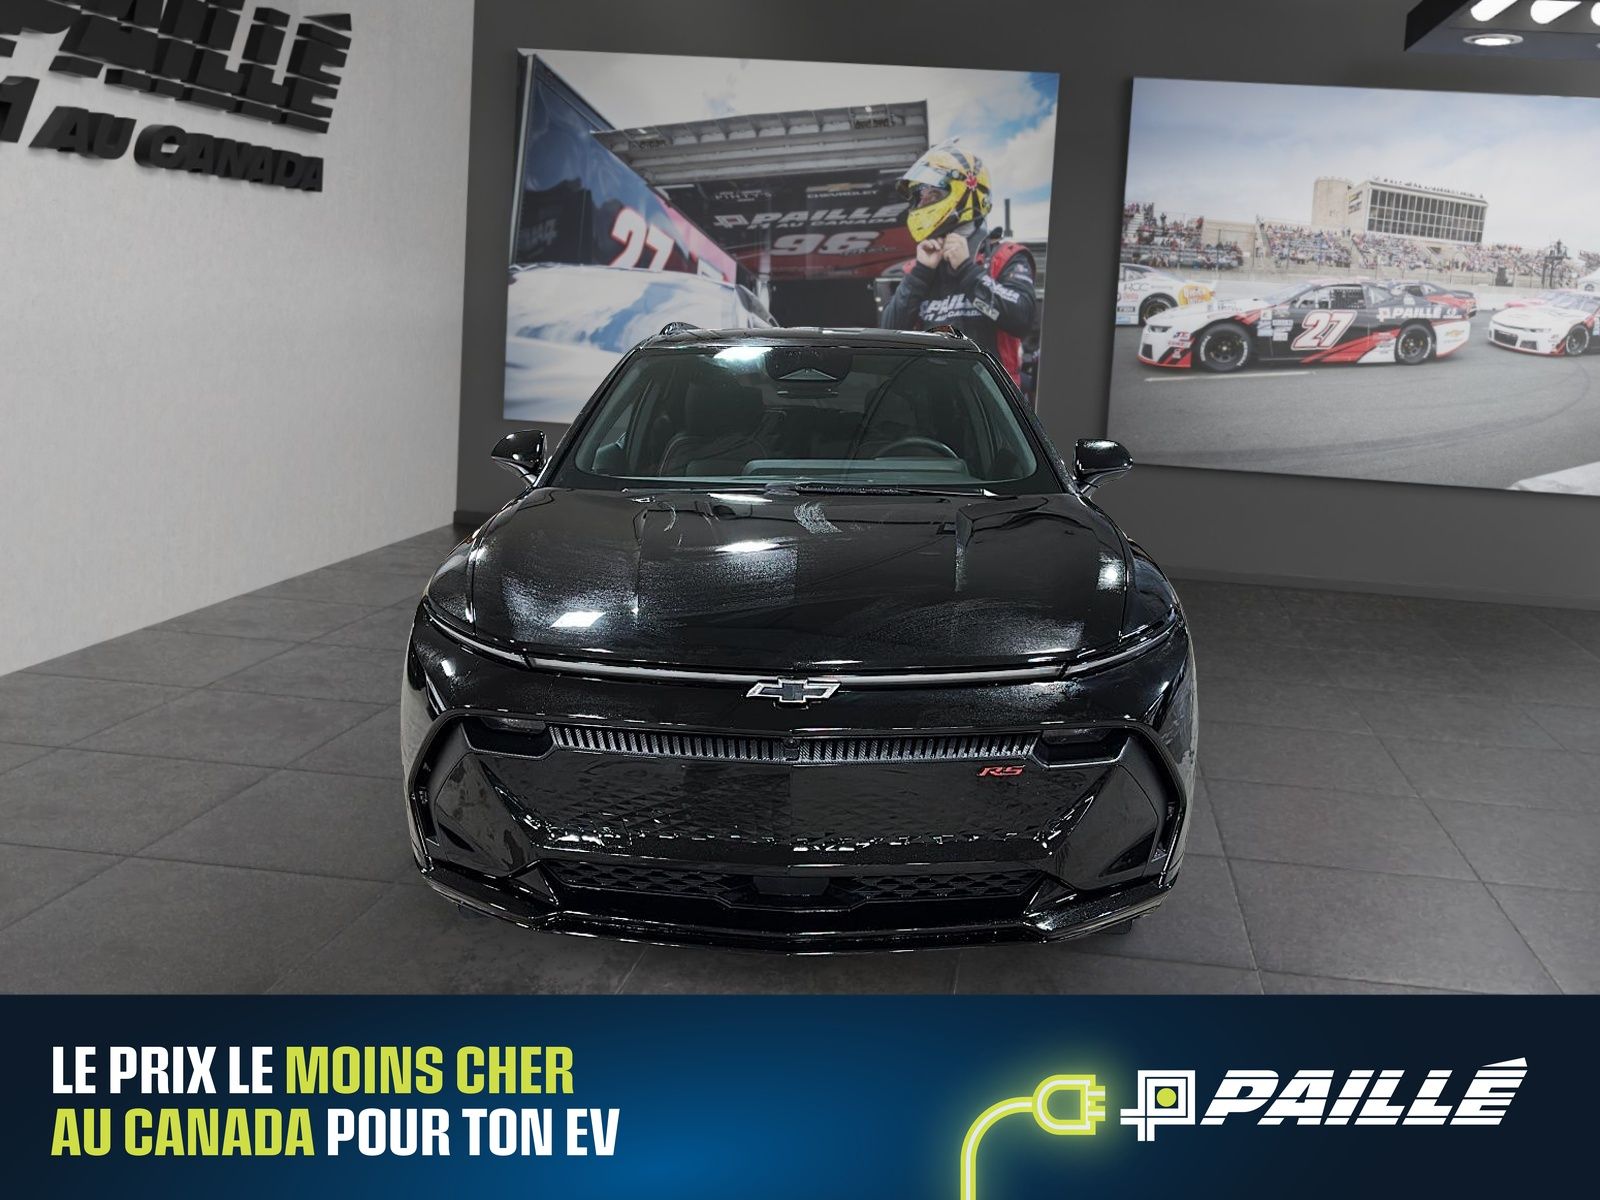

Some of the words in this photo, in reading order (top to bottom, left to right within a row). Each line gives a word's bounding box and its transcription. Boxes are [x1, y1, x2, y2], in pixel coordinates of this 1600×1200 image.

[28, 106, 137, 160] AU
[134, 124, 324, 192] CANADA
[811, 217, 897, 227] CANADA
[609, 207, 675, 272] 27
[770, 231, 881, 256] 96
[1290, 308, 1358, 351] 27
[976, 764, 1026, 778] RS
